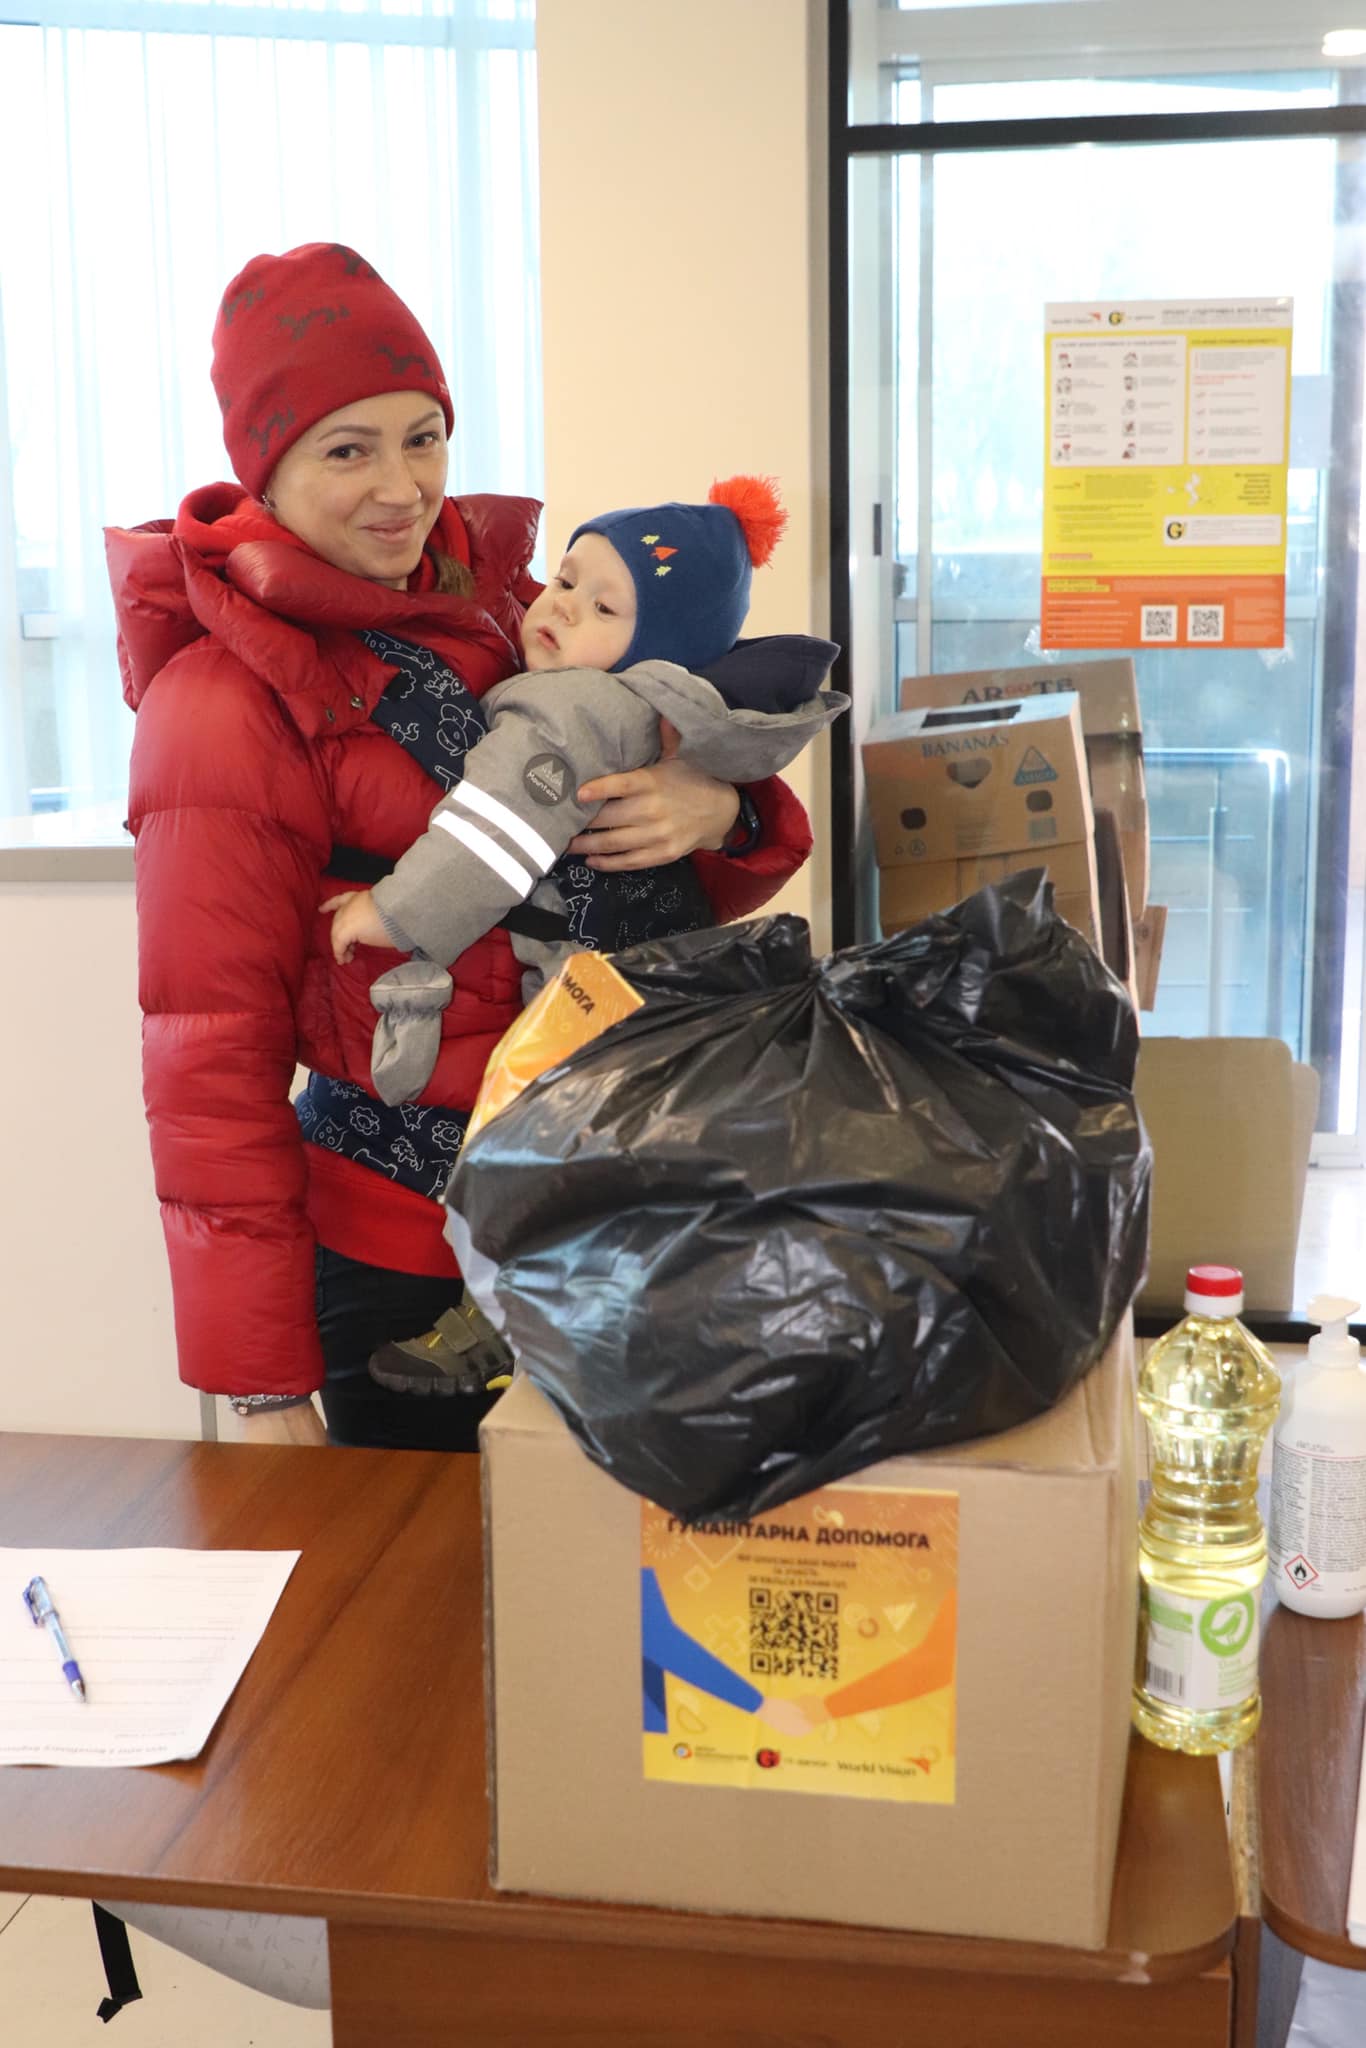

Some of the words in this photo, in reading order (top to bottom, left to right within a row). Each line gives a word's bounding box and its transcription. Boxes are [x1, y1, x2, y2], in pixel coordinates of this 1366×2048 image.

[923, 735, 1008, 757] BANANAS
[526, 771, 558, 801] Mountains
[815, 1526, 930, 1550] ДОПОМОГА
[836, 1759, 875, 1775] World
[879, 1762, 917, 1778] Vision
